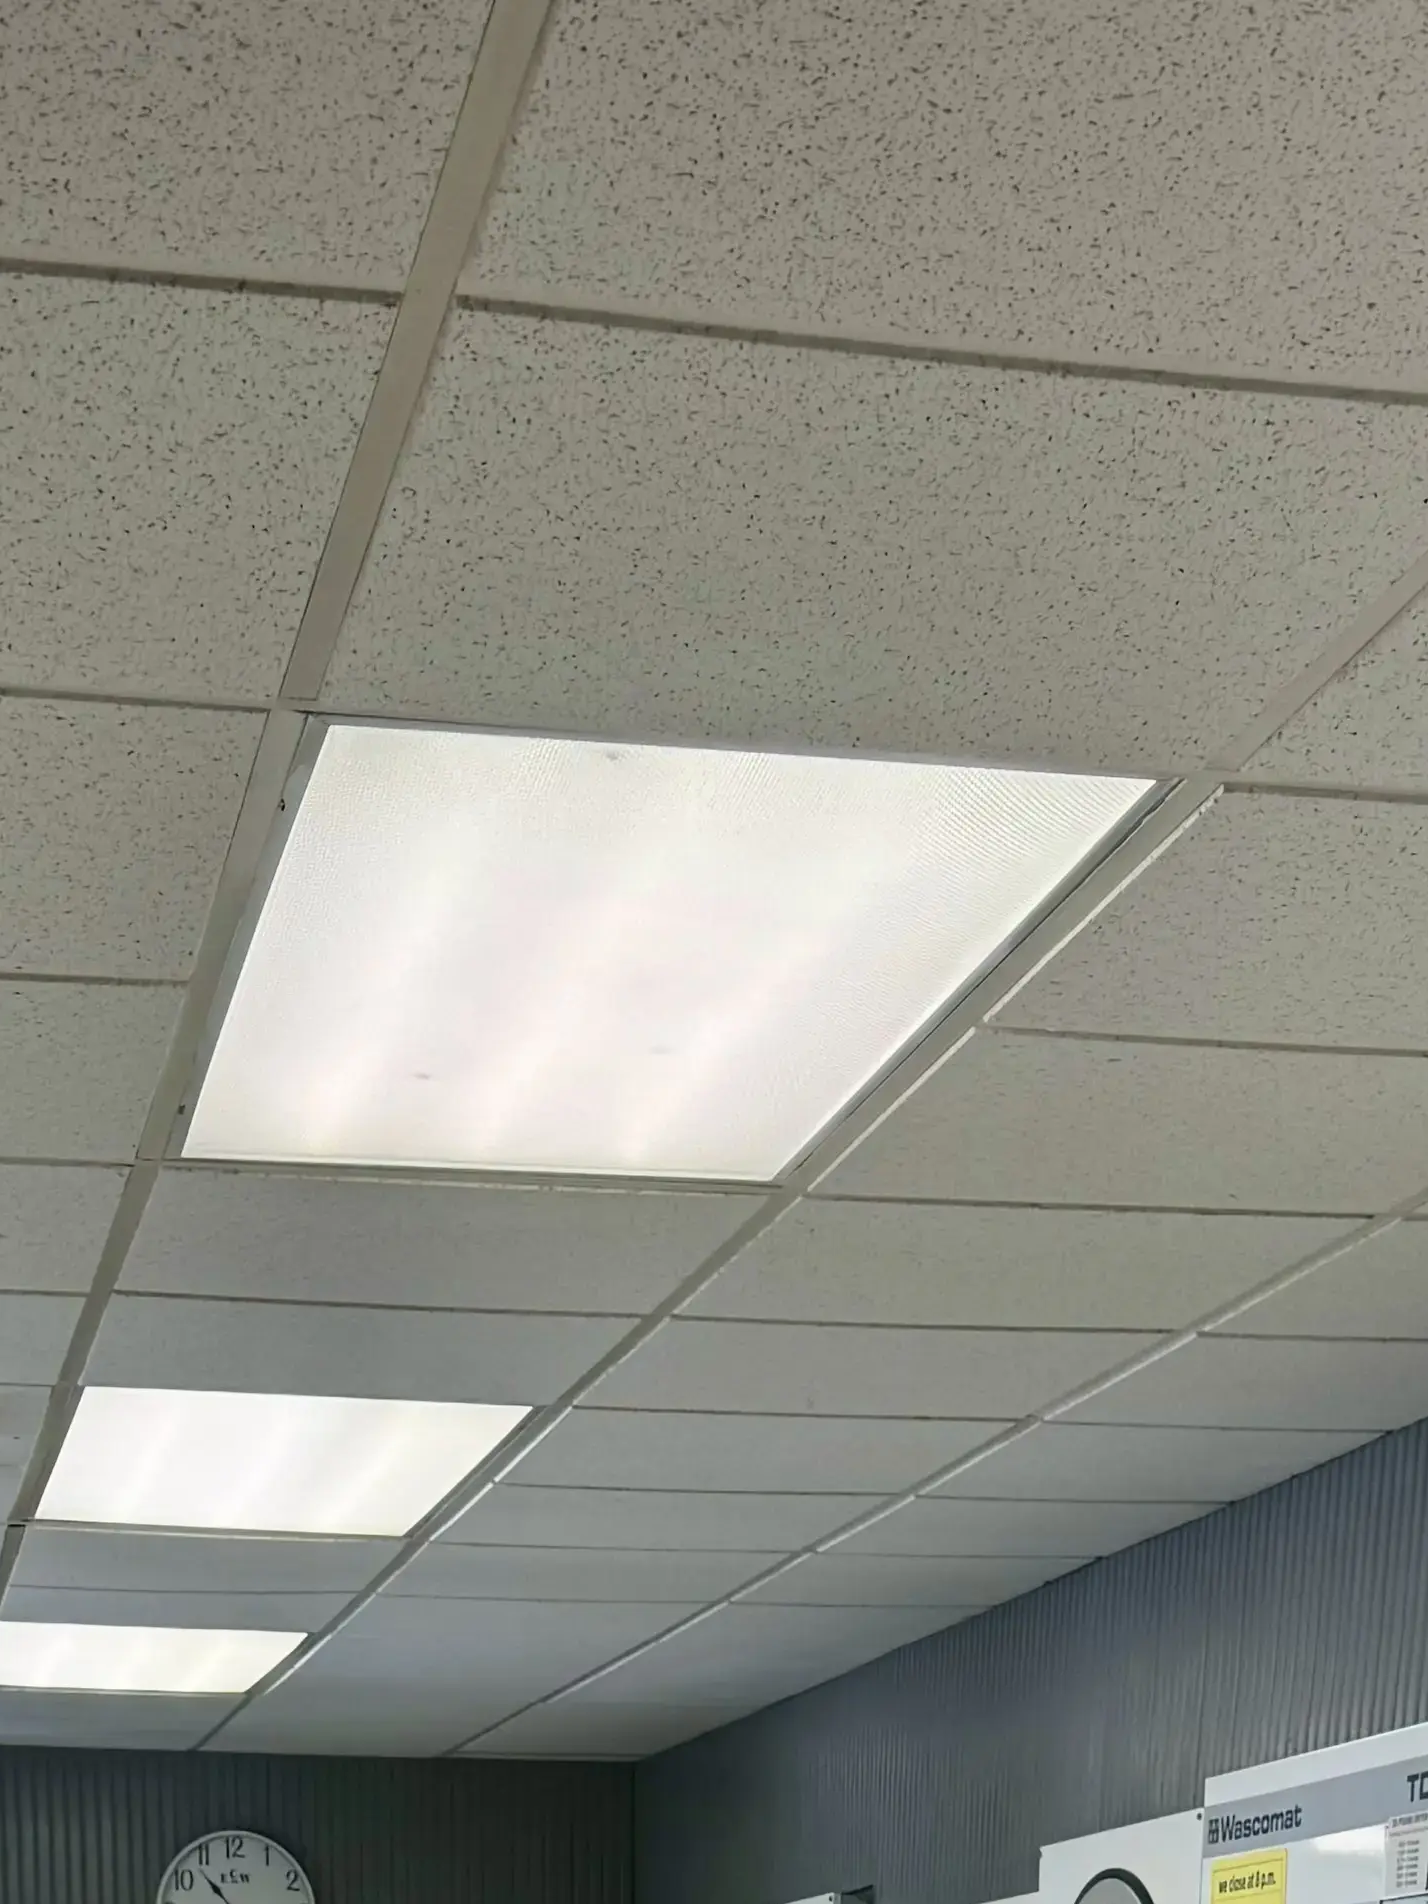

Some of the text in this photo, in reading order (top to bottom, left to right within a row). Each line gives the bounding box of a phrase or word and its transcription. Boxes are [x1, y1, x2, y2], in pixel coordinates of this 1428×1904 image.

[1220, 1804, 1303, 1842] Wascomat
[198, 1844, 210, 1866] 11
[225, 1836, 246, 1859] 12
[174, 1869, 194, 1891] 10
[286, 1870, 301, 1892] 2
